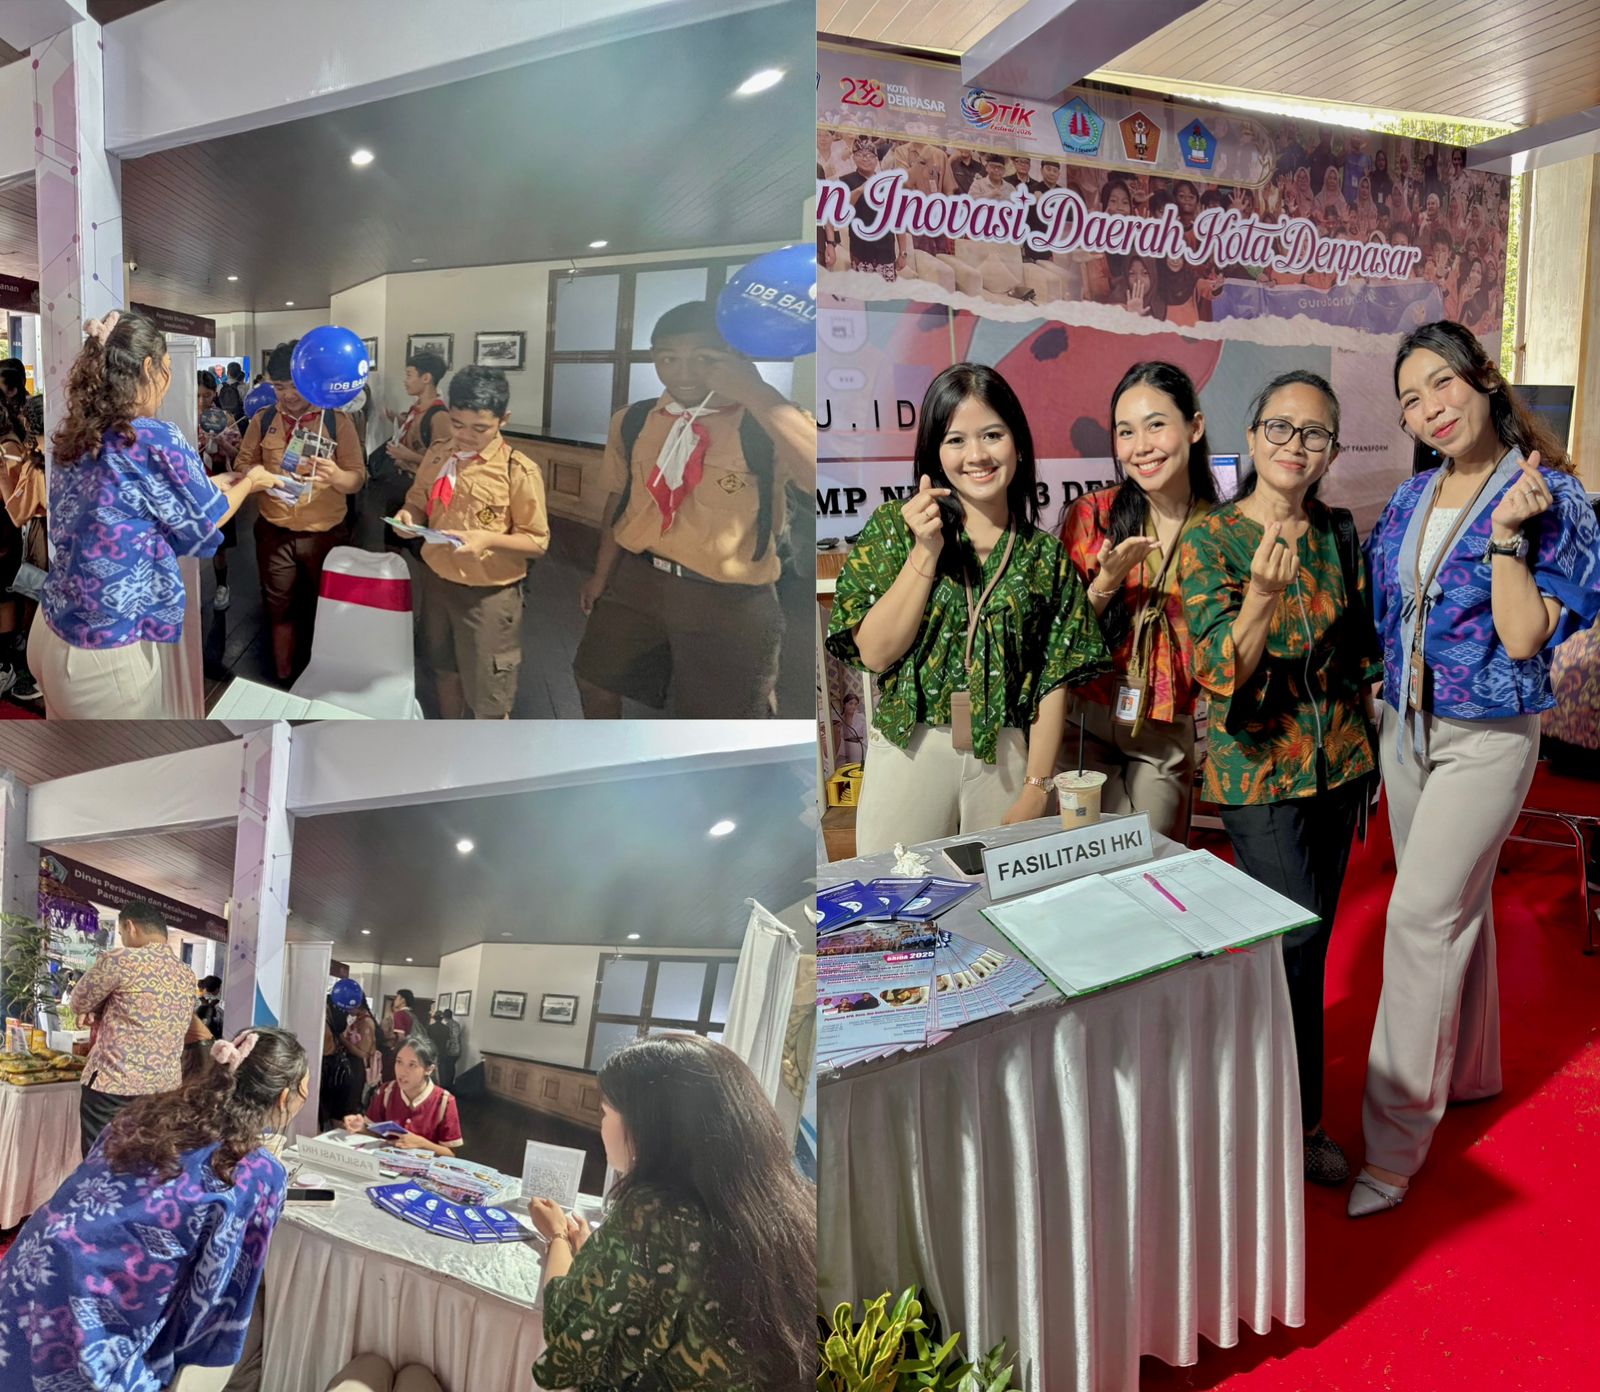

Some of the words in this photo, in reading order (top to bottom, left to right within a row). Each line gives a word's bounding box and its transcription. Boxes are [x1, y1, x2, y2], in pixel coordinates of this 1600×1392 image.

[887, 83, 909, 95] KOTA
[887, 93, 946, 112] DENPASAR
[857, 173, 1029, 240] Inovasi
[1032, 191, 1187, 257] Daerah
[1187, 211, 1286, 264] Kota
[1275, 220, 1420, 284] Denpasar
[745, 282, 778, 300] IDB
[330, 382, 350, 391] IDB
[1036, 481, 1050, 506] 3
[997, 838, 1107, 882] FASILITASI
[1112, 830, 1144, 854] HKI
[74, 869, 102, 886] Dinas
[104, 880, 147, 903] Perikanan
[148, 896, 162, 907] dan
[909, 951, 935, 959] 2025
